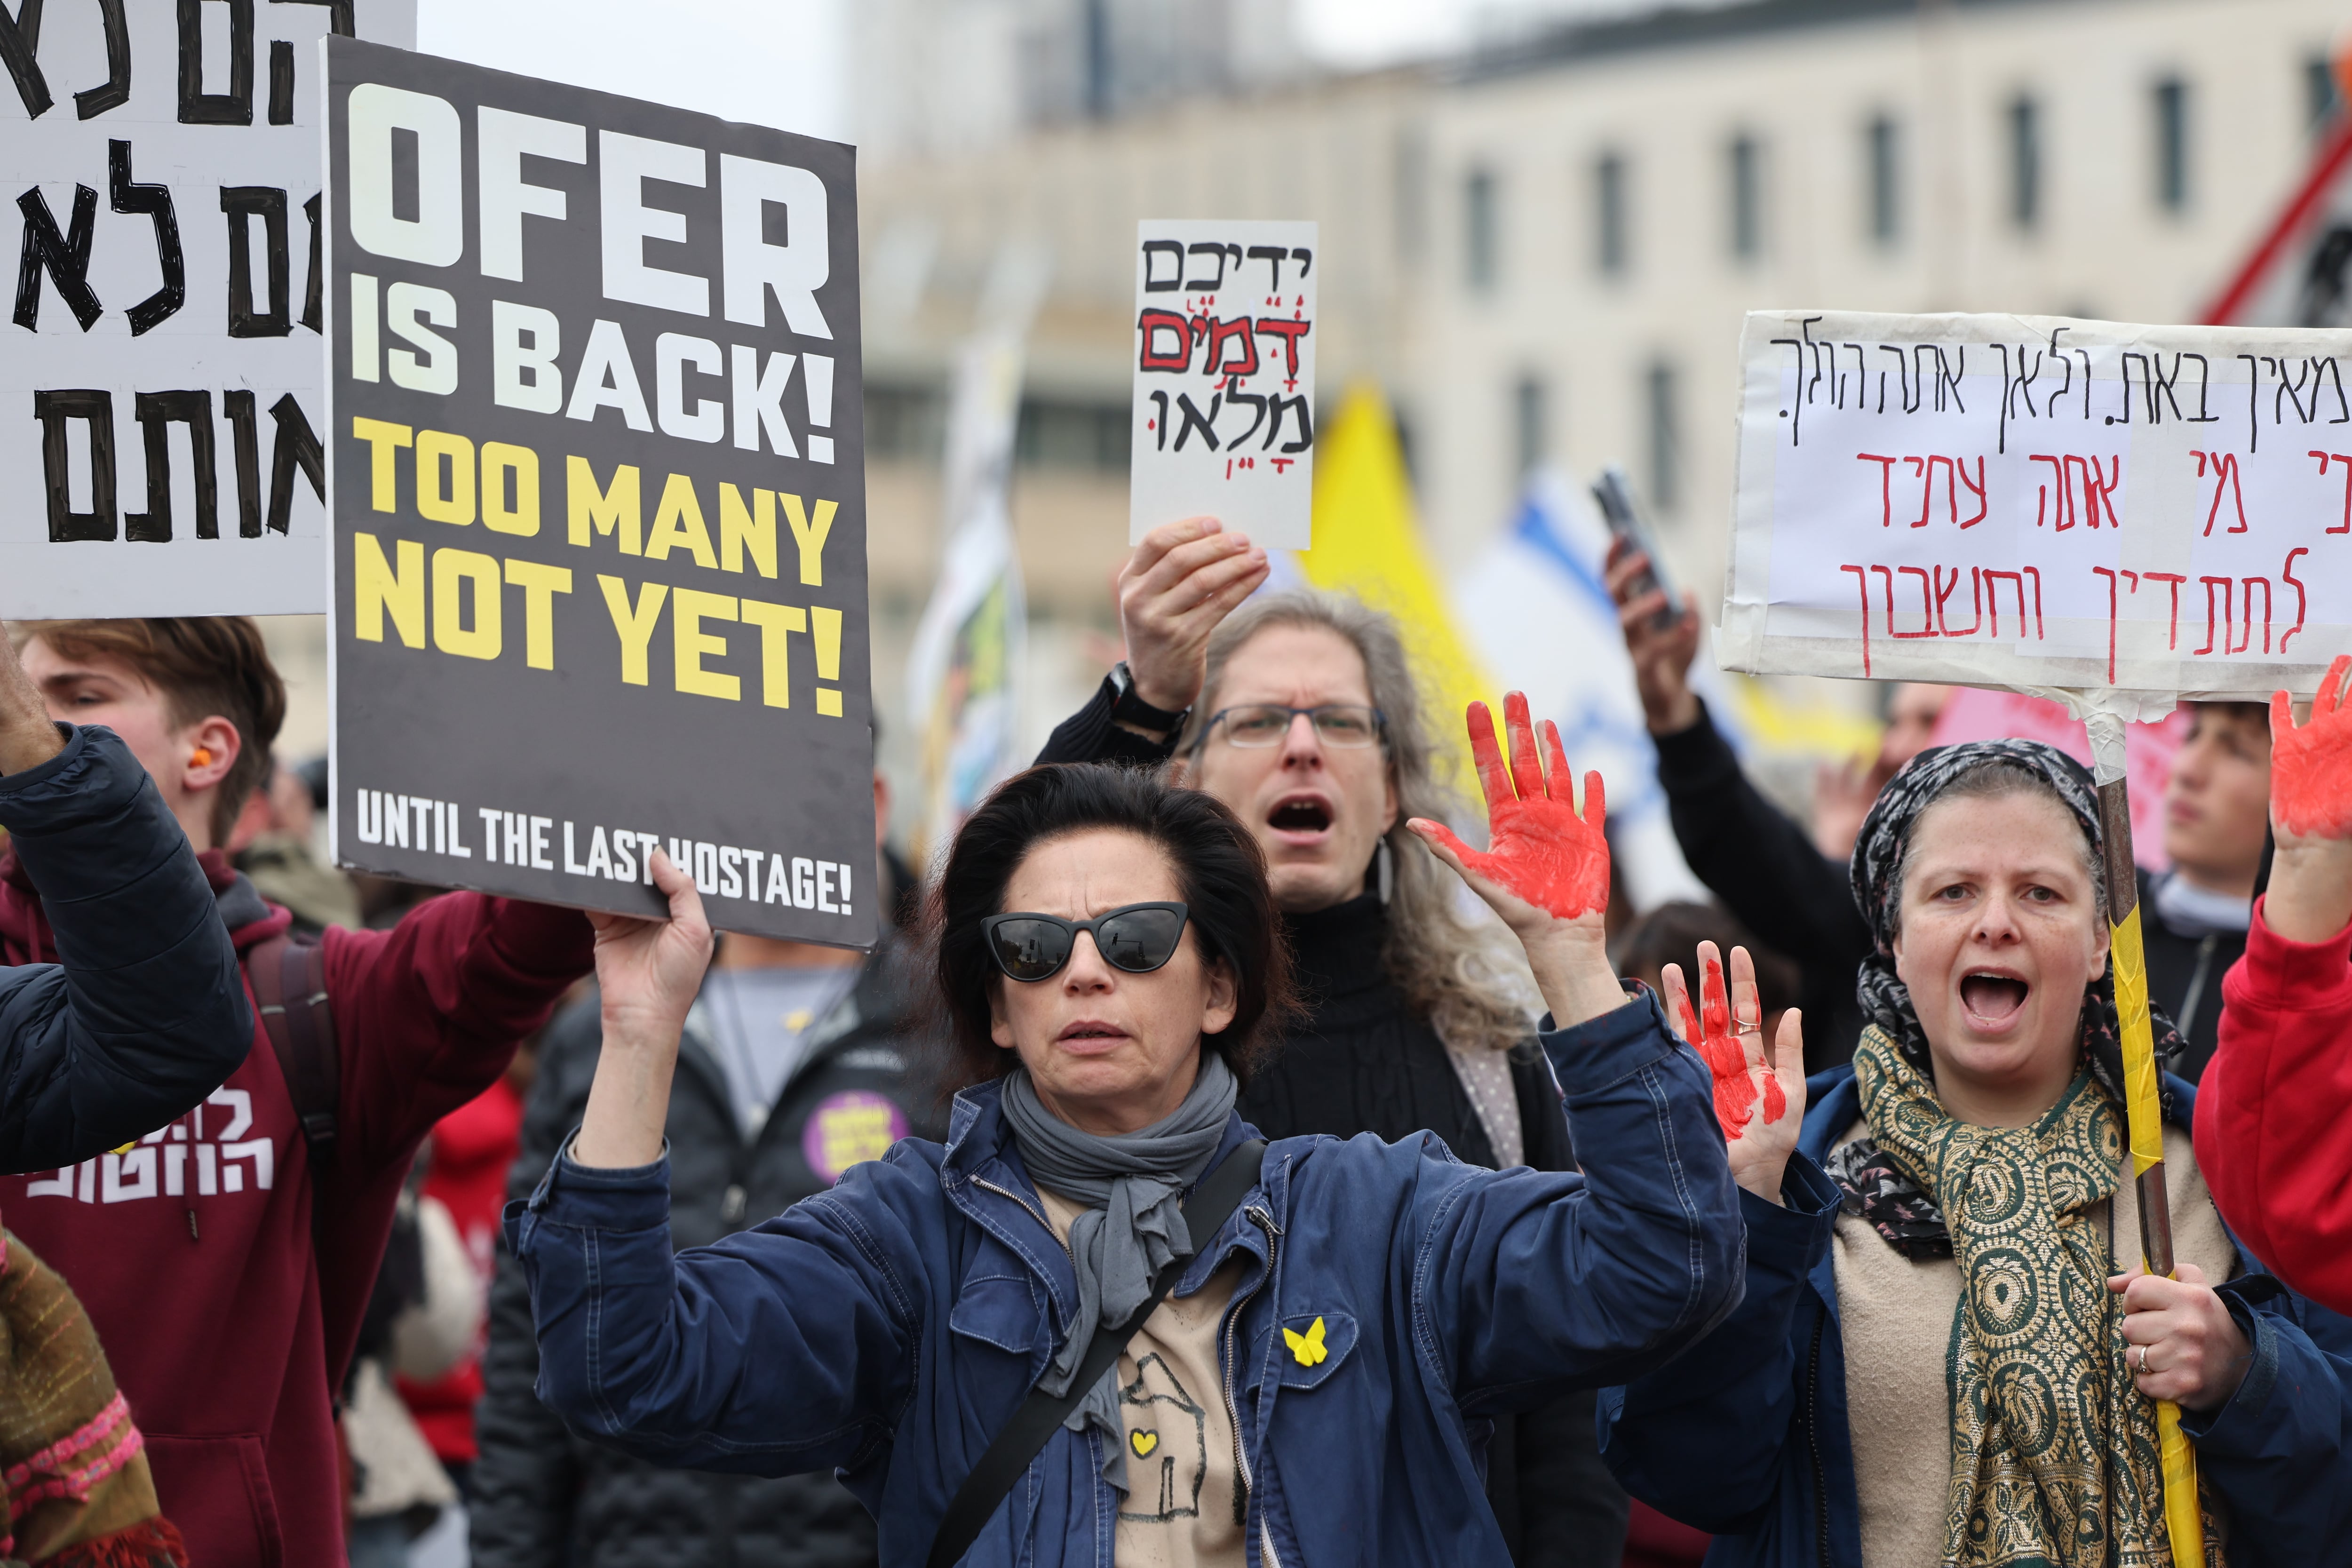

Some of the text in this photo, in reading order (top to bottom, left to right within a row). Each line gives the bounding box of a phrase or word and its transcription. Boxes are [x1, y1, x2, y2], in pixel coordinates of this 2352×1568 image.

[13, 138, 325, 338] ם לא
[349, 83, 834, 340] OFER
[351, 272, 834, 465] IS BACK!
[1878, 345, 1965, 414] אתה
[34, 389, 325, 543] אותם
[353, 416, 839, 587] TOO MANY
[1857, 454, 1987, 529] עתיד
[2029, 454, 2118, 532] אתה
[2189, 450, 2248, 537] מי
[355, 532, 842, 717] NOT YET!
[358, 788, 852, 915] UNTIL THE LAST HOSTAGE!
